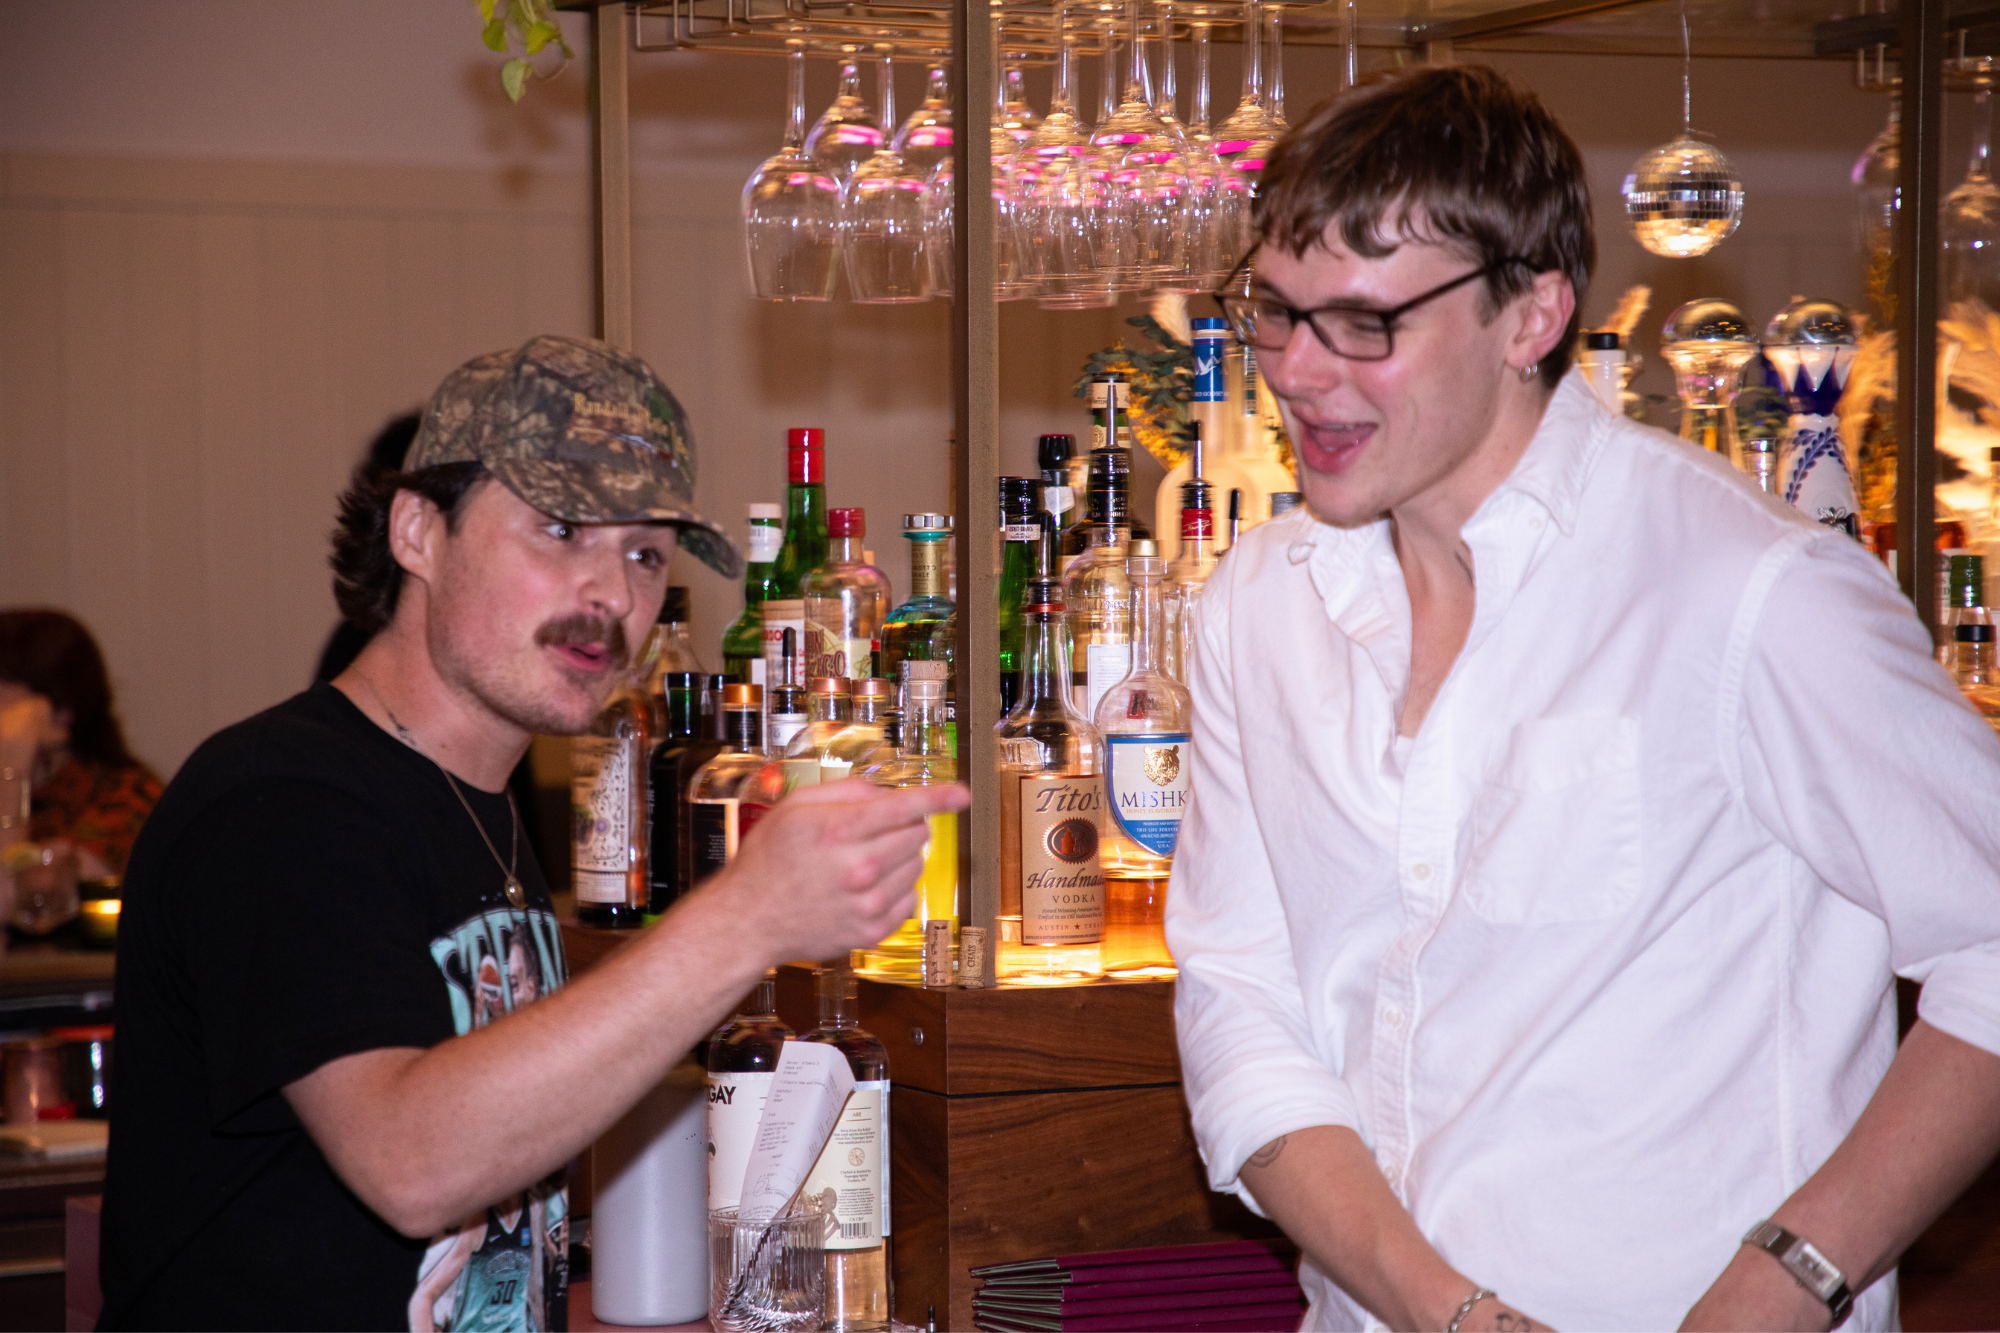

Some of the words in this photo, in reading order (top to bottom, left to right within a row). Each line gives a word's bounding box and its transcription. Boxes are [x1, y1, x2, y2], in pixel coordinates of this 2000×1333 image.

[1036, 784, 1101, 813] Tito's
[1121, 791, 1187, 808] MISHK
[1052, 894, 1096, 904] VODKA
[967, 945, 976, 967] CHAIS
[491, 1280, 518, 1305] 30
